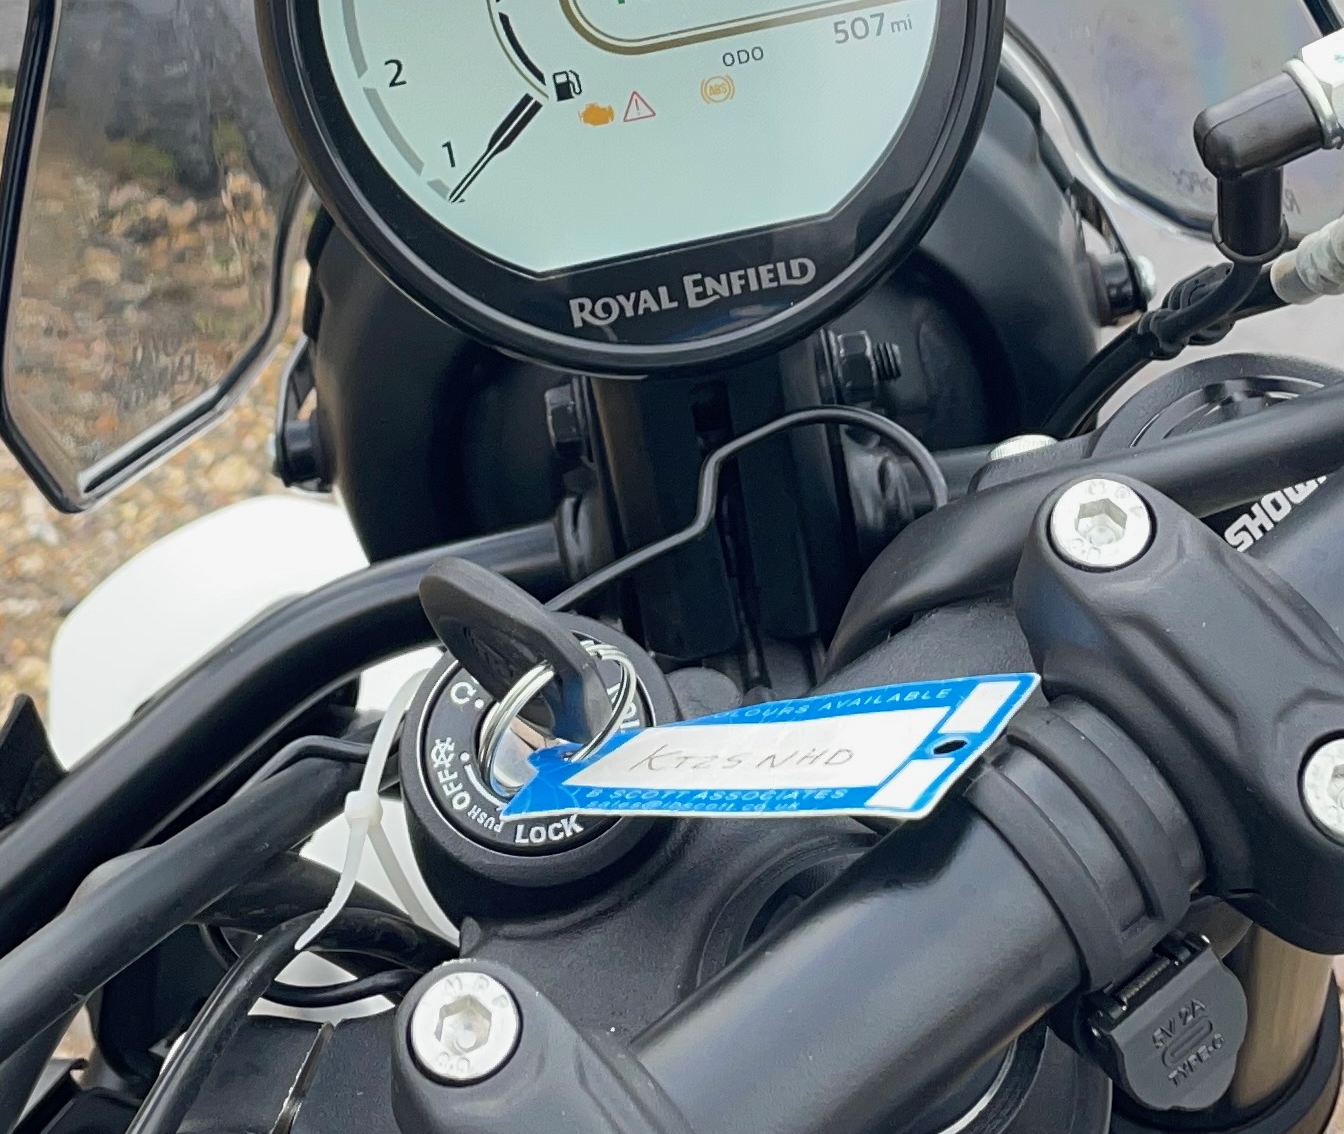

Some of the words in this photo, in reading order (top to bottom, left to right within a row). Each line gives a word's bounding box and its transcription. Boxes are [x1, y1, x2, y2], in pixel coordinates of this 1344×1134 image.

[833, 12, 886, 45] 507
[890, 13, 913, 34] mi
[722, 46, 765, 67] ODO
[384, 59, 408, 89] 2
[708, 82, 728, 97] ABS
[442, 141, 457, 169] 1
[569, 285, 679, 328] ROYAL
[682, 257, 817, 309] ENFIELD
[1224, 475, 1328, 553] SHOW
[817, 687, 954, 712] AVAILABLE
[437, 764, 472, 811] OFF
[609, 789, 690, 800] SCOTT
[691, 788, 849, 801] ASSOCIATES
[467, 804, 505, 834] PUSH
[514, 814, 585, 845] LOCK
